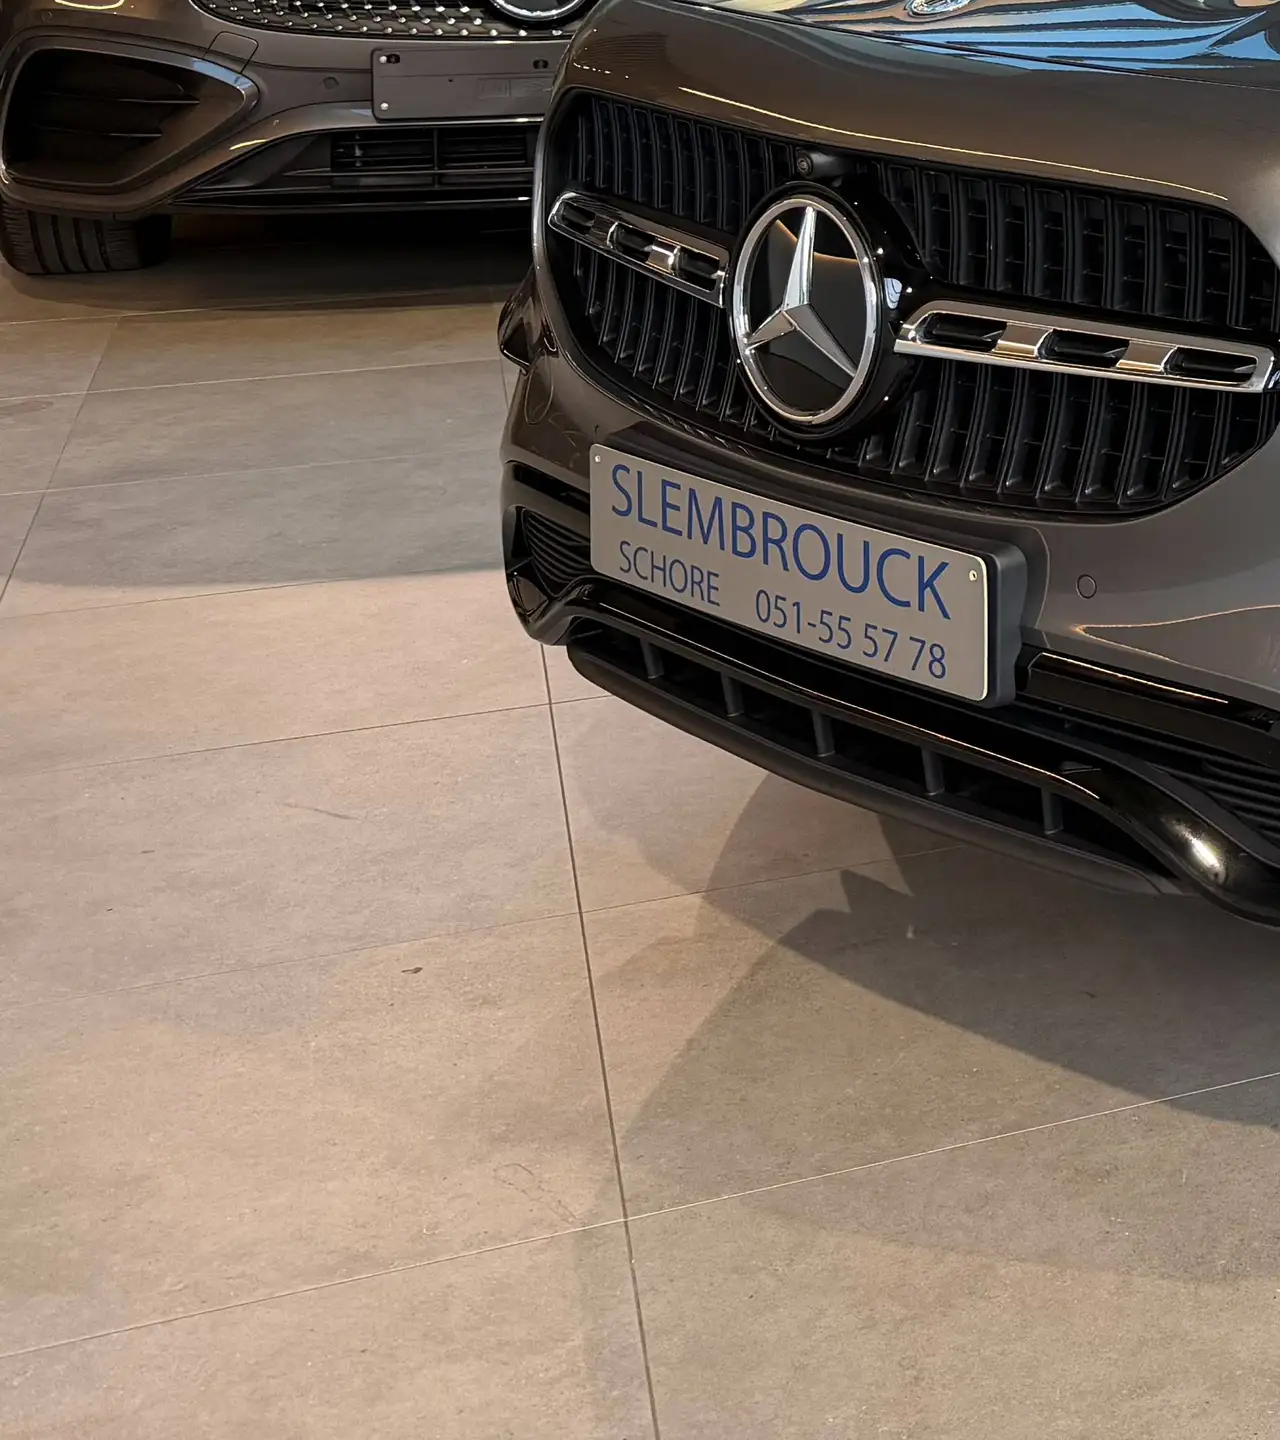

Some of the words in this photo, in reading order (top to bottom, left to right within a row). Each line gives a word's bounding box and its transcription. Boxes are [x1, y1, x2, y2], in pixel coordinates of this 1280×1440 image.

[611, 463, 953, 620] SLEMBROUCK
[618, 539, 721, 608] SCHORE
[755, 588, 853, 650] 051-55
[862, 622, 899, 664] 57
[908, 635, 948, 680] 78
